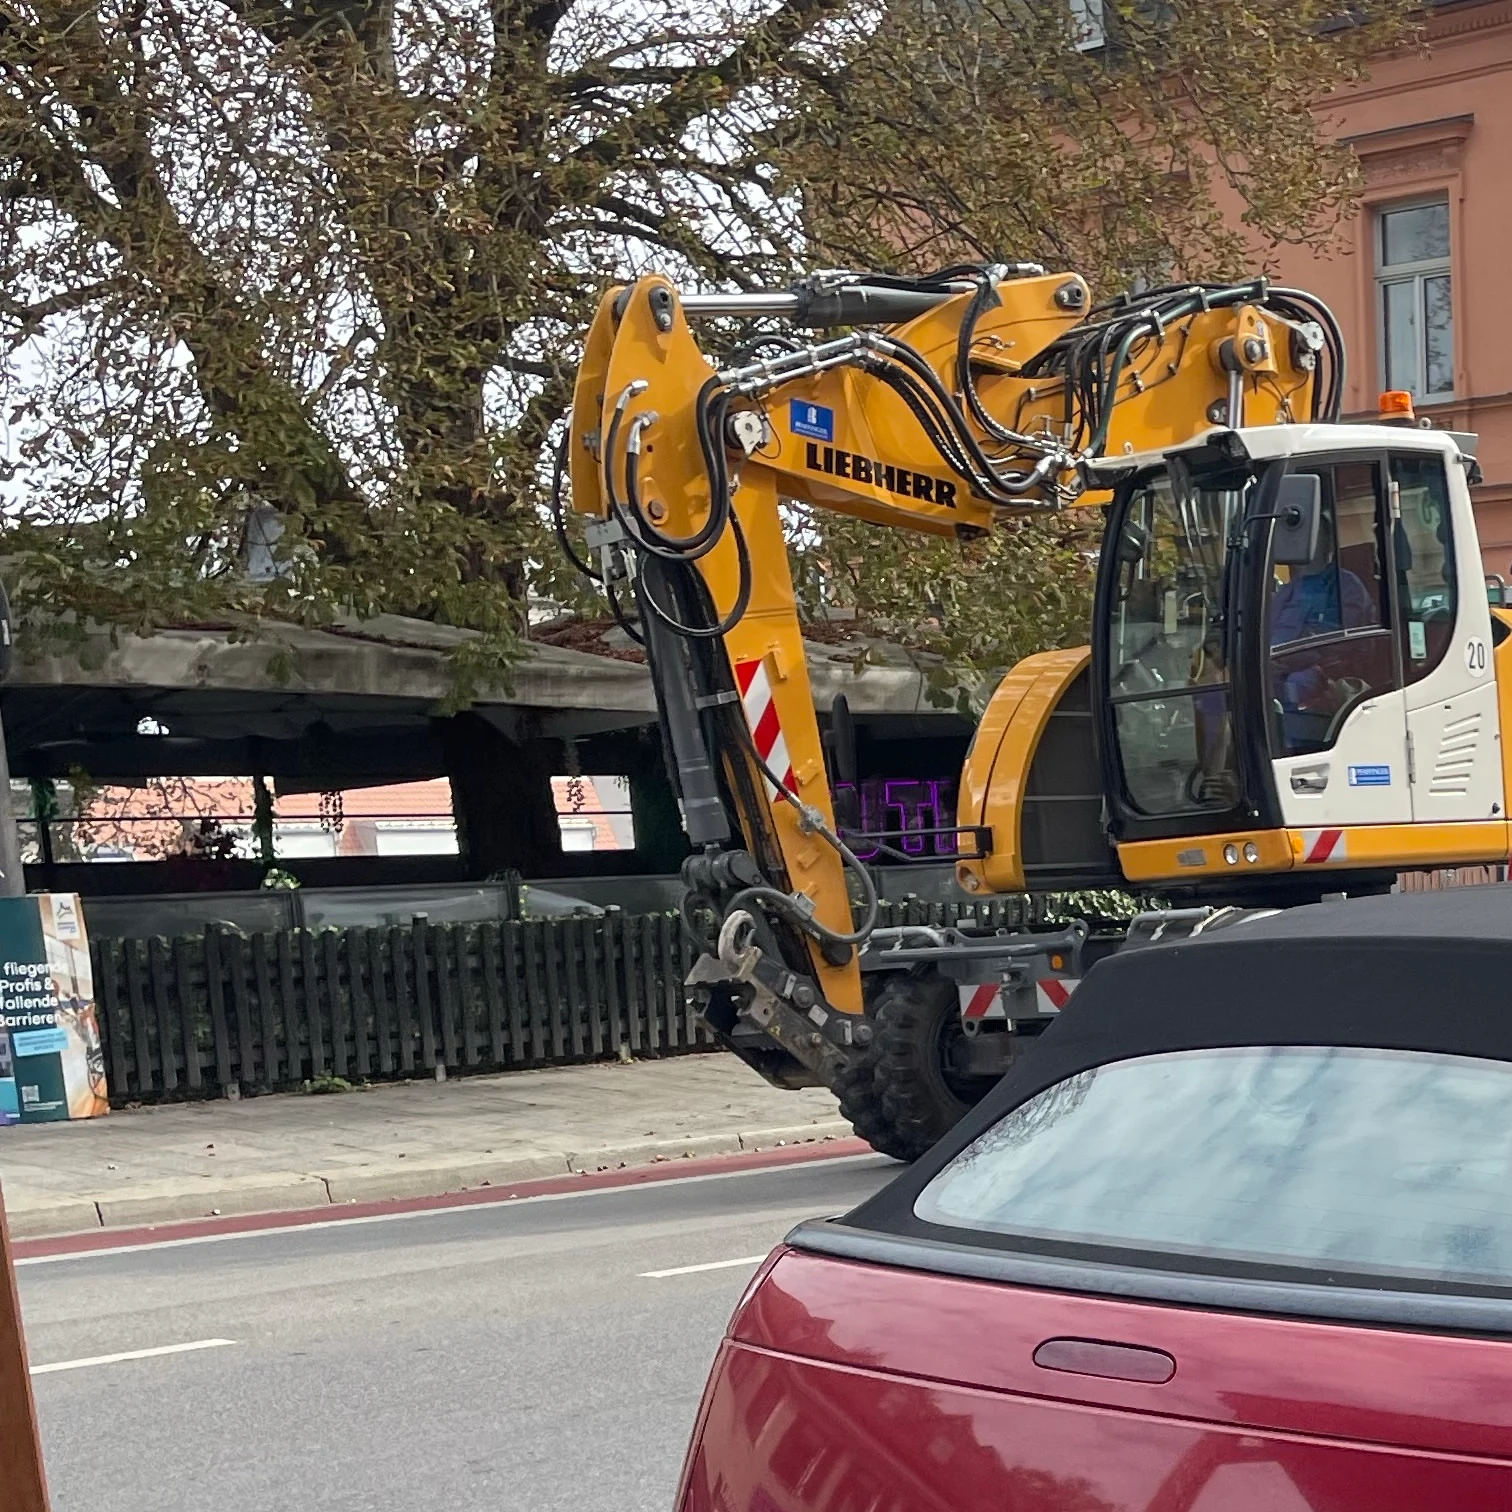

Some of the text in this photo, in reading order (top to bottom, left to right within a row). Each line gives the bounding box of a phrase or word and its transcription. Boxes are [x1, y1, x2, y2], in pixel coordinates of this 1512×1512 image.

[806, 442, 957, 508] LIEBHERR
[1467, 641, 1485, 670] 20
[0, 976, 55, 993] Profis &
